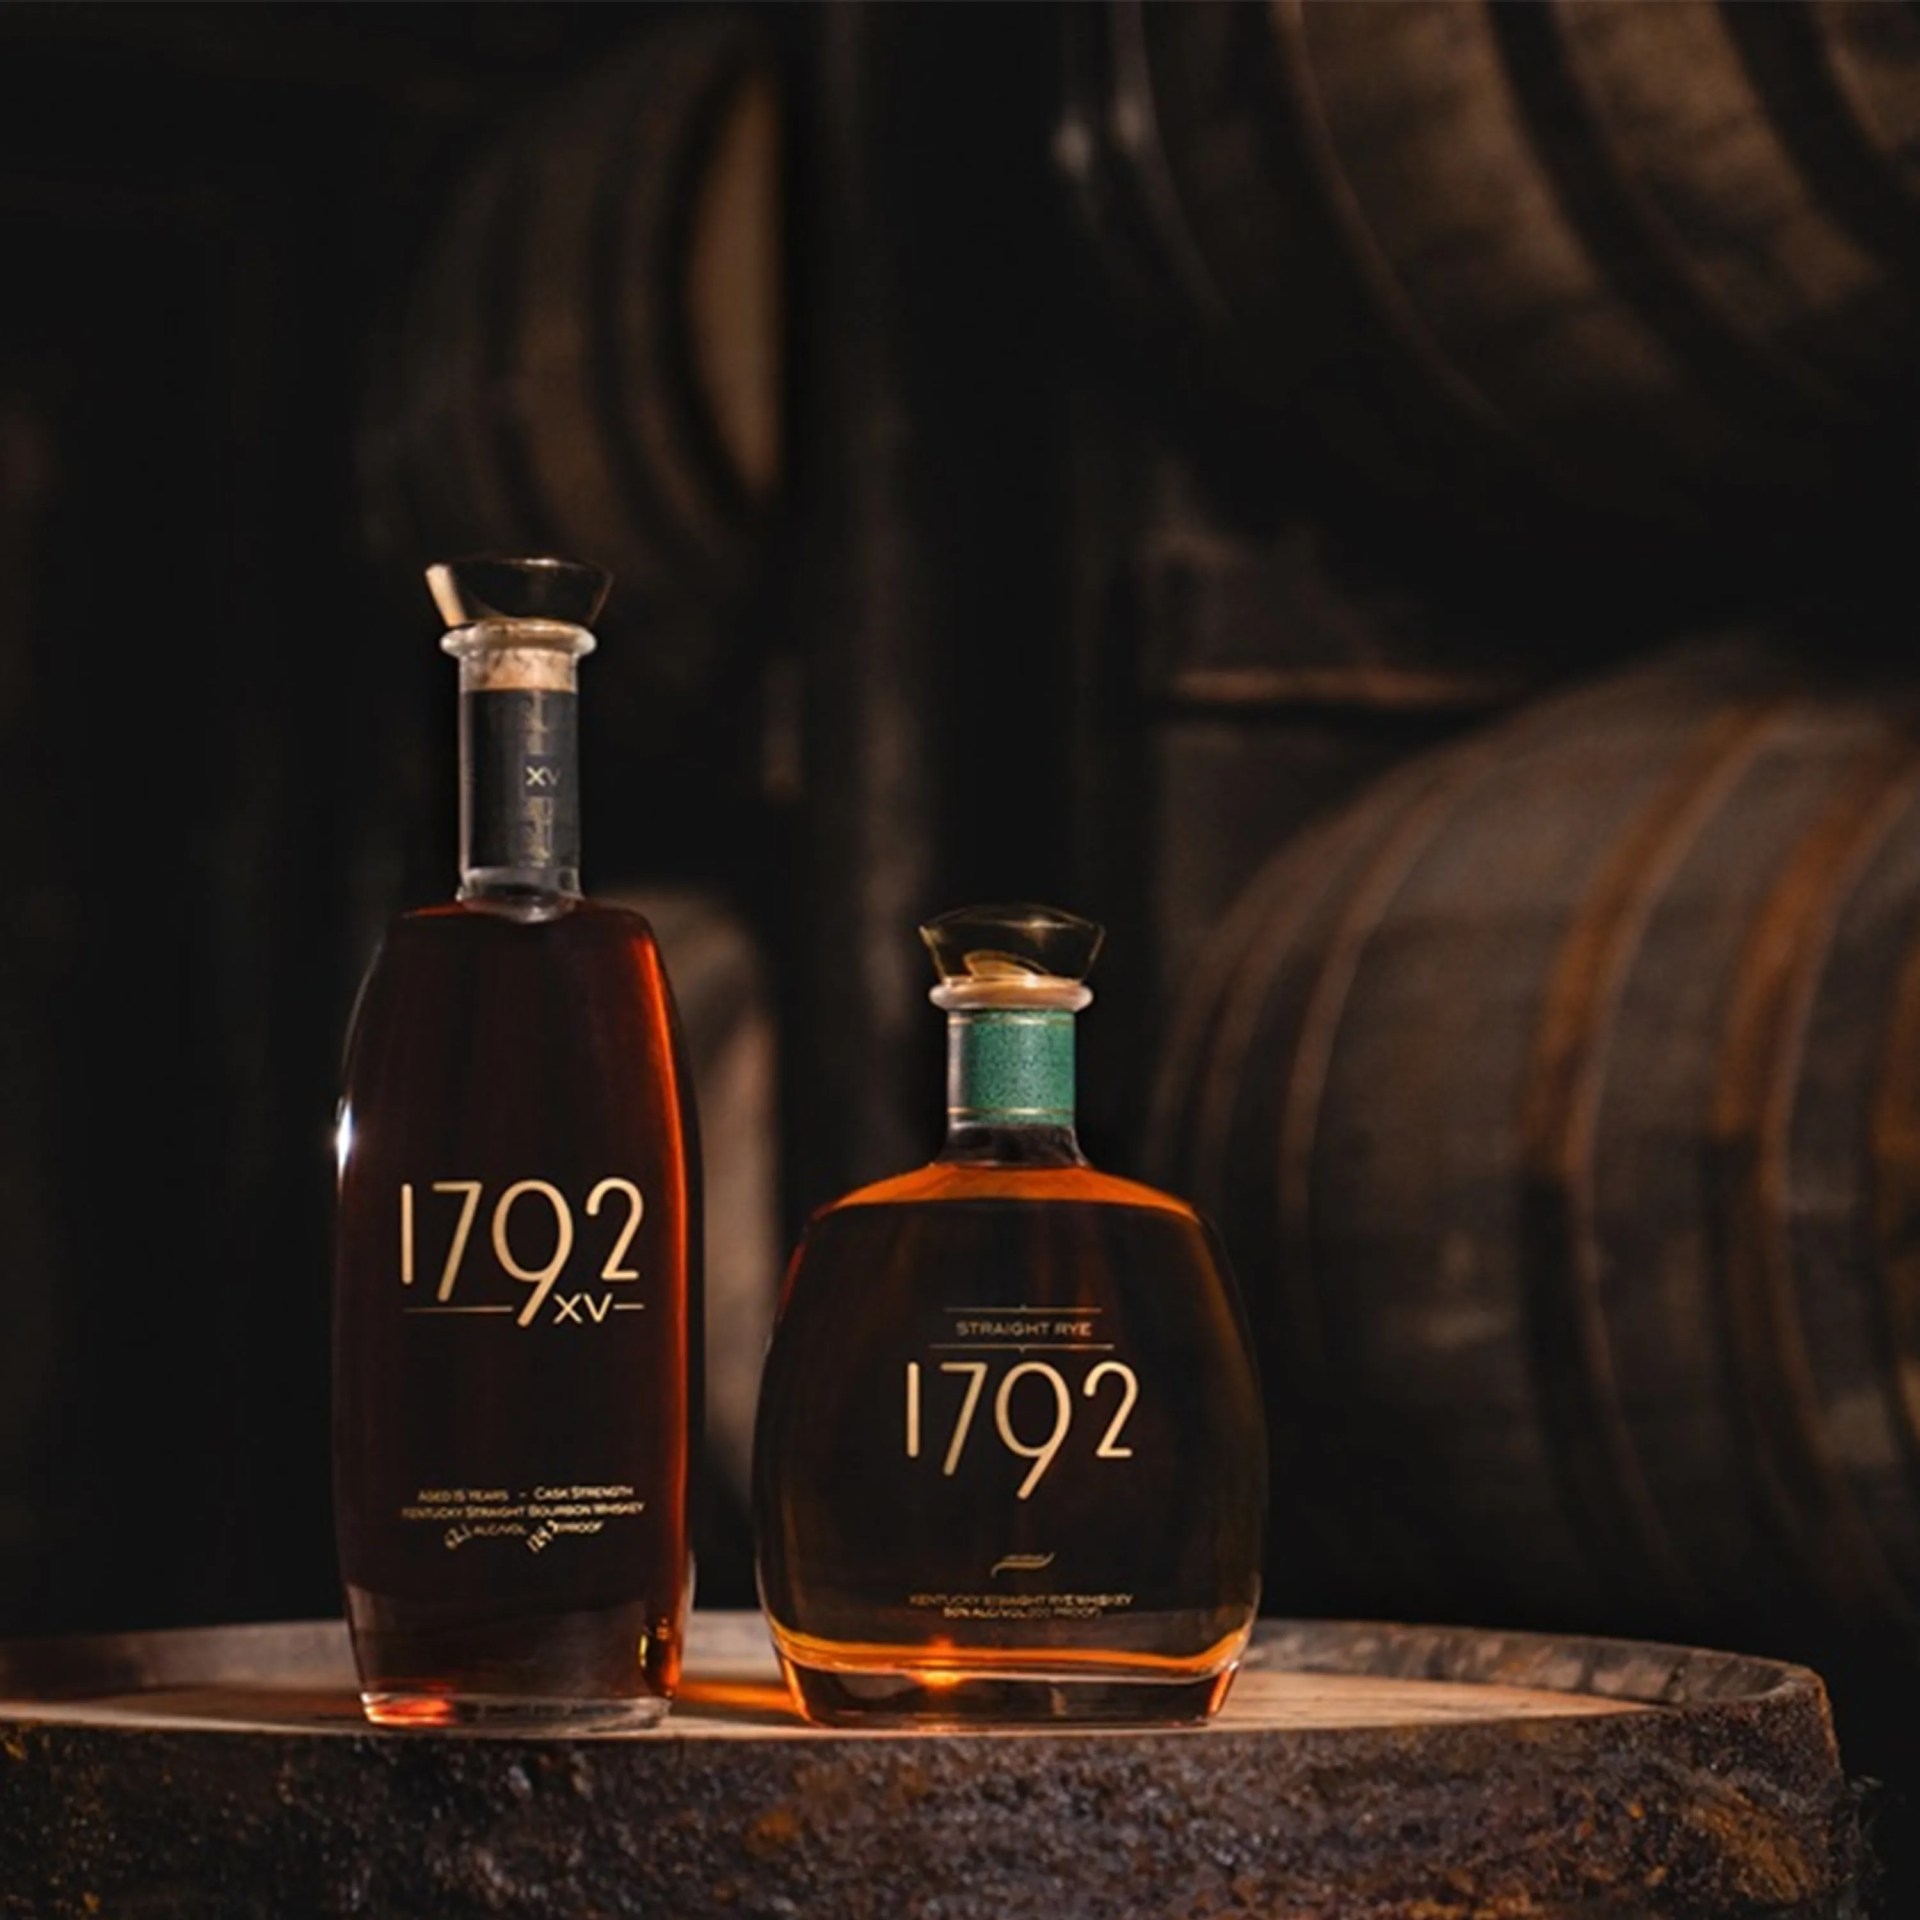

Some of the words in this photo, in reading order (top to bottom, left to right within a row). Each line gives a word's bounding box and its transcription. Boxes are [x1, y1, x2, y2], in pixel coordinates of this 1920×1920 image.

[402, 1177, 643, 1326] 1792
[553, 1293, 613, 1324] XV
[956, 1321, 1049, 1336] STRAIGHT
[1055, 1321, 1092, 1336] RYE
[907, 1360, 1138, 1499] 1792
